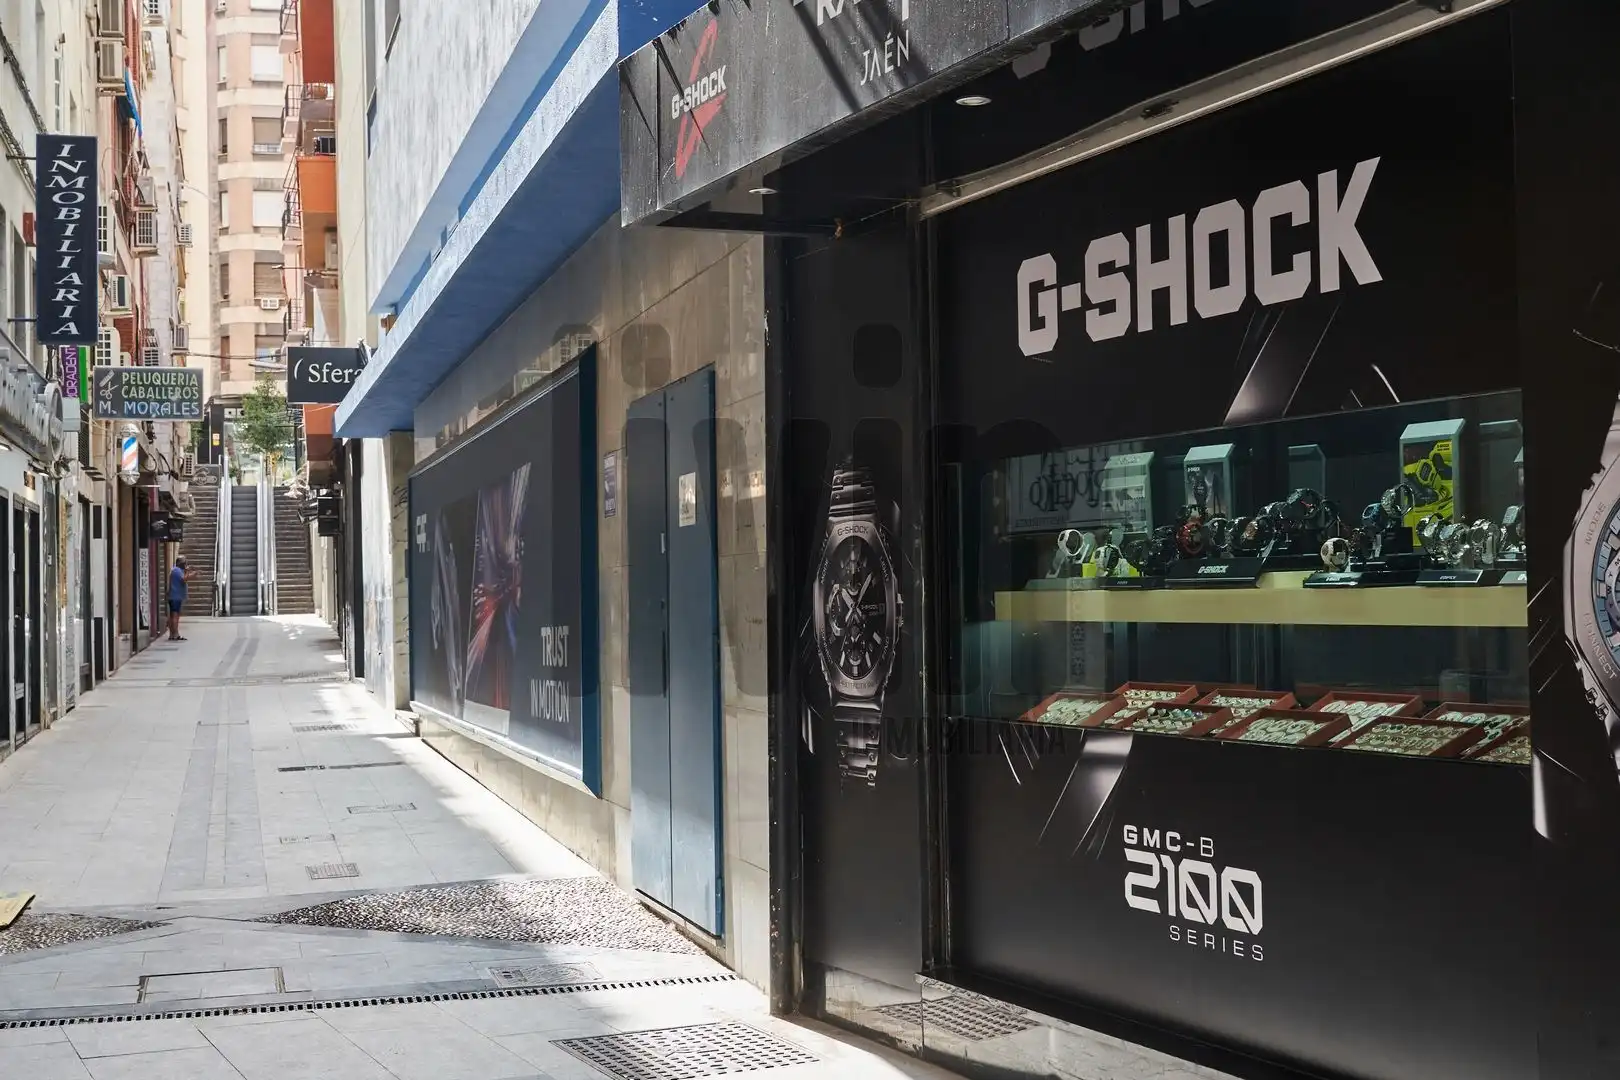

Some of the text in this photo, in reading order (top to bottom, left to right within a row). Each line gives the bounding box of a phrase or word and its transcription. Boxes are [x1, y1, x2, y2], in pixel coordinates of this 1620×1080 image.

[860, 29, 909, 86] JAÉN
[671, 65, 727, 120] G-SHOCK
[46, 143, 89, 336] INMOBILIARIA
[1017, 156, 1384, 357] G-SHOCK
[121, 385, 199, 400] CABALLEROS
[122, 372, 198, 387] PELUQUERIA
[124, 401, 200, 416] MORALES
[541, 625, 570, 667] TRUST
[539, 679, 570, 723] MOTION
[1123, 824, 1214, 857] GMC-B
[1124, 848, 1263, 935] 2100
[1169, 925, 1264, 962] SERIES
